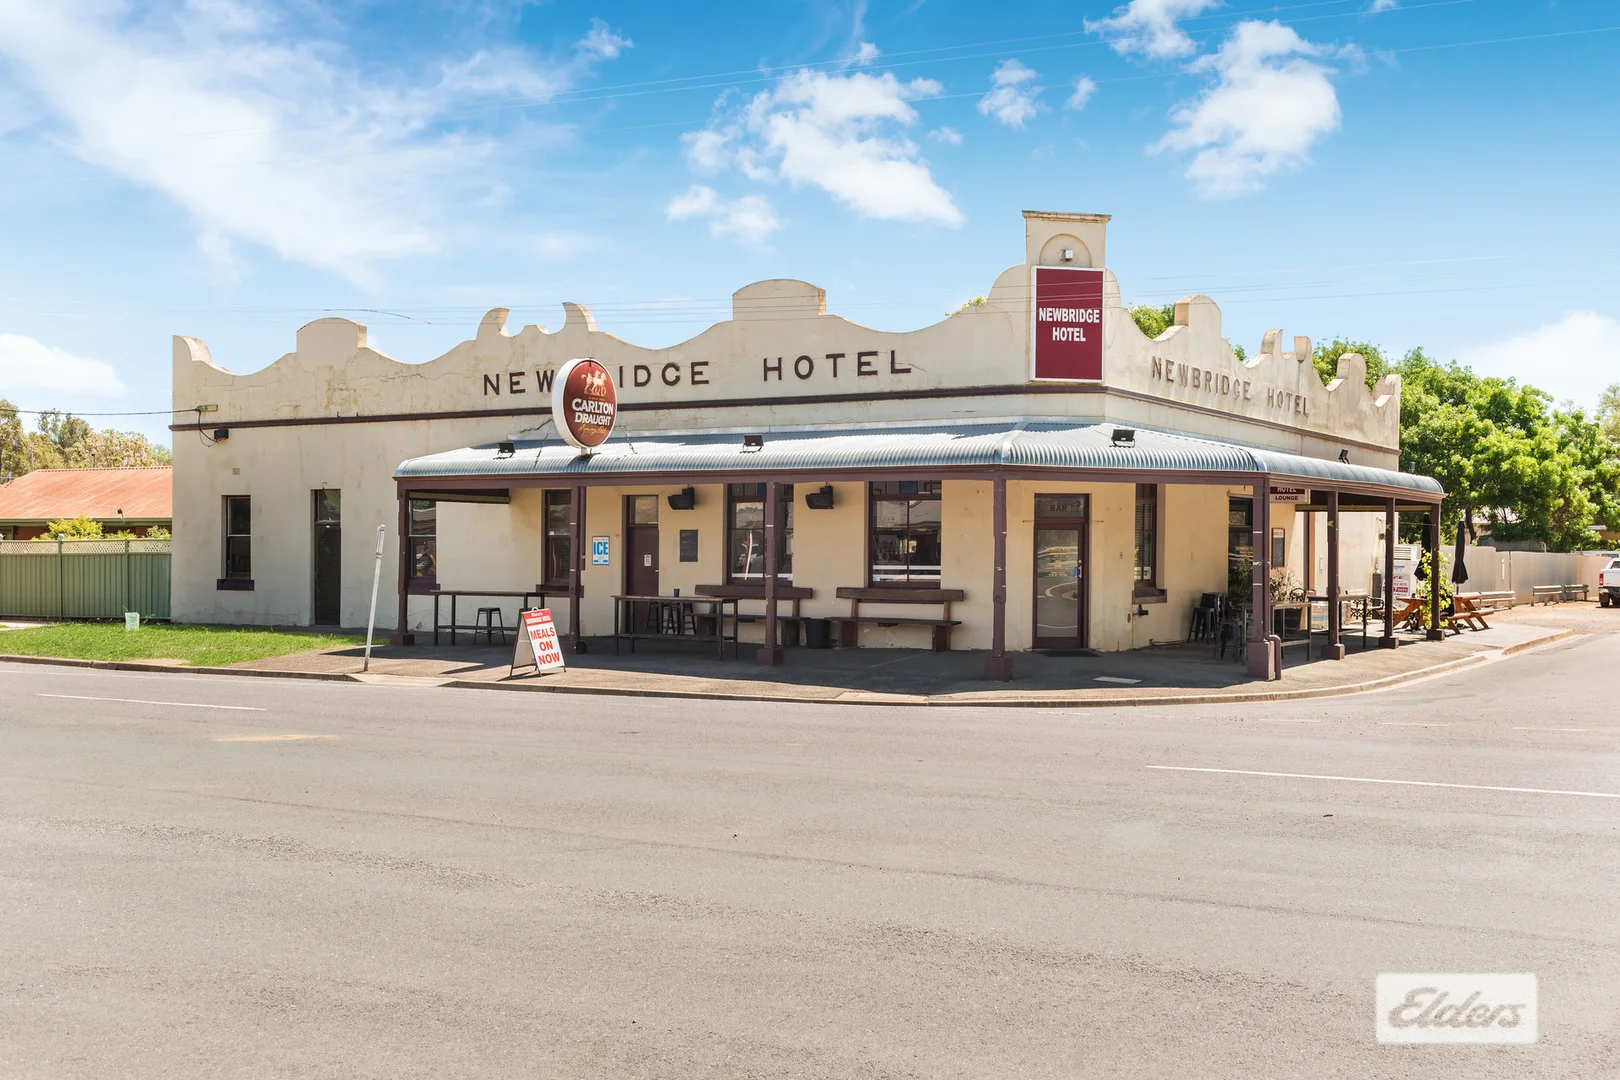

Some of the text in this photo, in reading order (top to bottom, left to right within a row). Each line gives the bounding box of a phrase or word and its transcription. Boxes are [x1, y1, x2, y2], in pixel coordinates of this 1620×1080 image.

[1038, 307, 1100, 323] NEWBRIDGE
[1052, 327, 1087, 342] HOTEL
[483, 350, 912, 396] NEWIDGE HOTEL
[1151, 355, 1309, 417] NEWBRIDGE HOTEL
[571, 397, 615, 415] CARLTON
[574, 412, 612, 426] DRAUGHT
[1049, 504, 1068, 512] BAR
[593, 541, 609, 556] ICE
[530, 627, 556, 640] MEALS
[538, 640, 554, 652] ON
[537, 652, 561, 665] NOW
